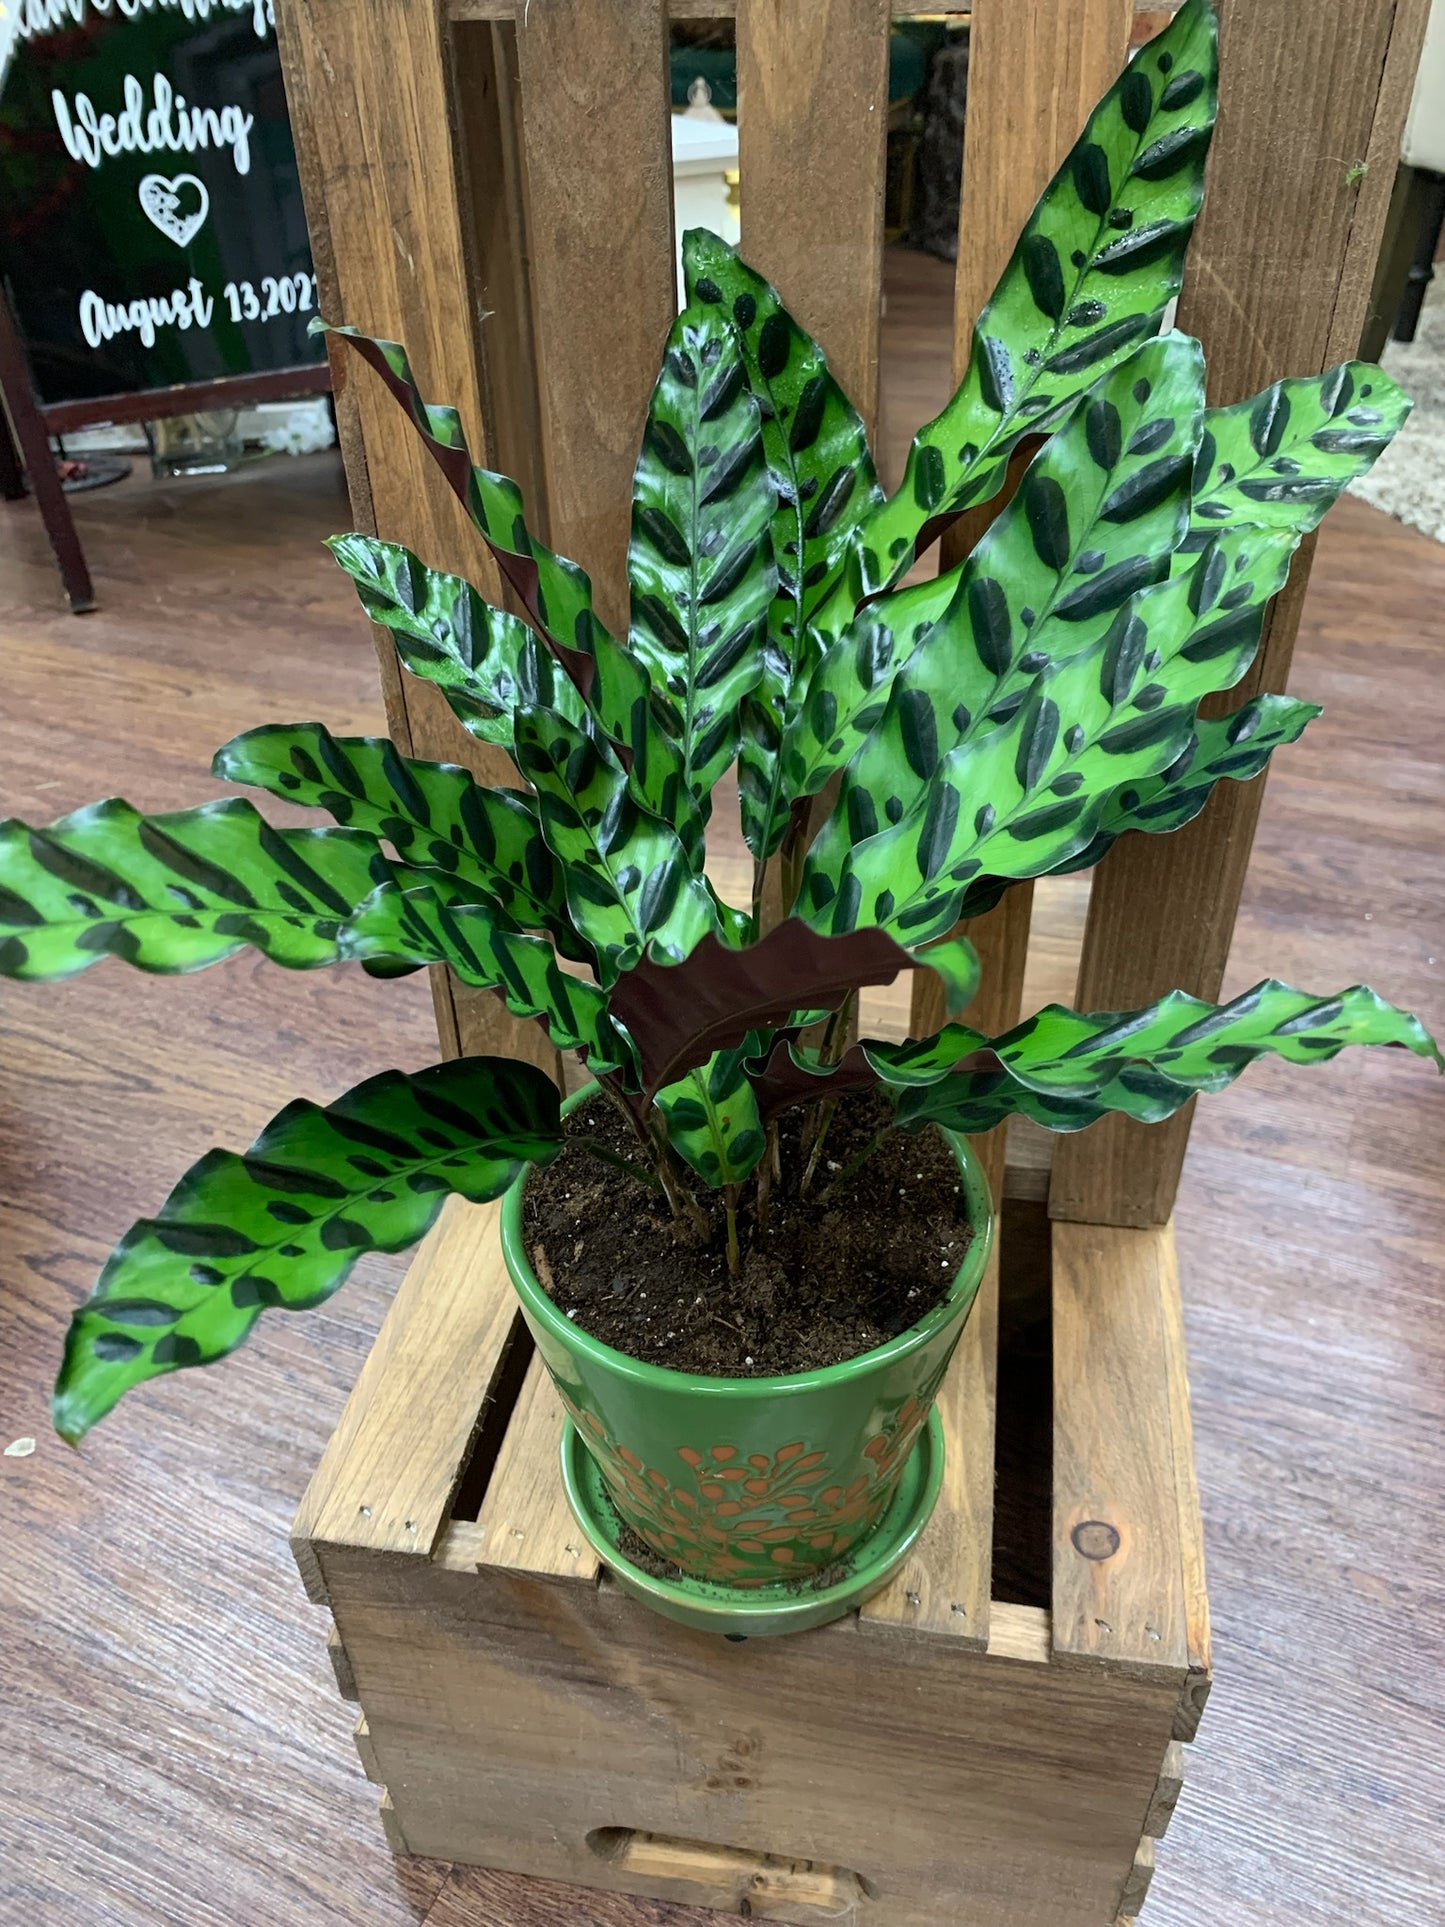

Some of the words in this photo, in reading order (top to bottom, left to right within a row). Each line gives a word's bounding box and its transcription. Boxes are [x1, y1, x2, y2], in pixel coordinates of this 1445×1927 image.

[52, 72, 254, 175] Wedding
[79, 277, 214, 348] August
[223, 271, 320, 323] 13,202
